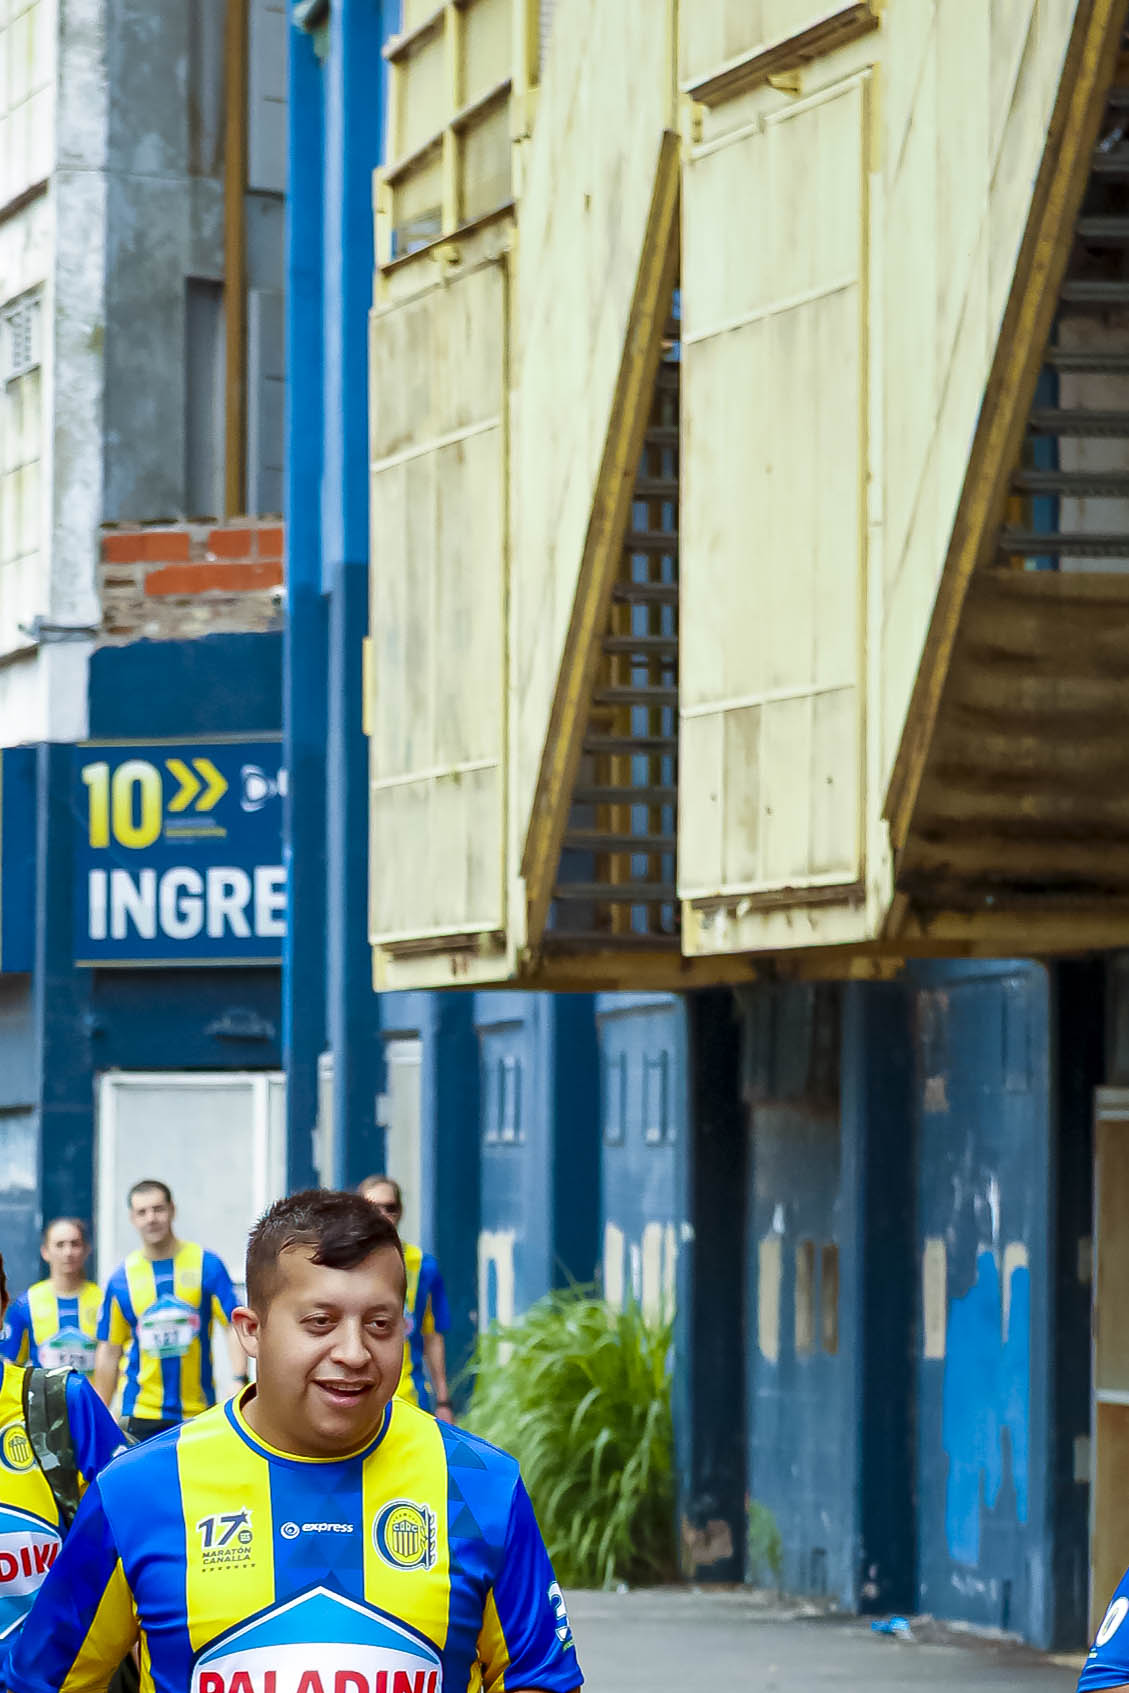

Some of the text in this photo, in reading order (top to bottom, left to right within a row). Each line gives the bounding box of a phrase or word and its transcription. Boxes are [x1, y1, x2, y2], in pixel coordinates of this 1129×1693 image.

[81, 759, 163, 849] 10
[88, 866, 287, 940] INGRE
[198, 1512, 249, 1548] 17
[302, 1522, 354, 1533] express
